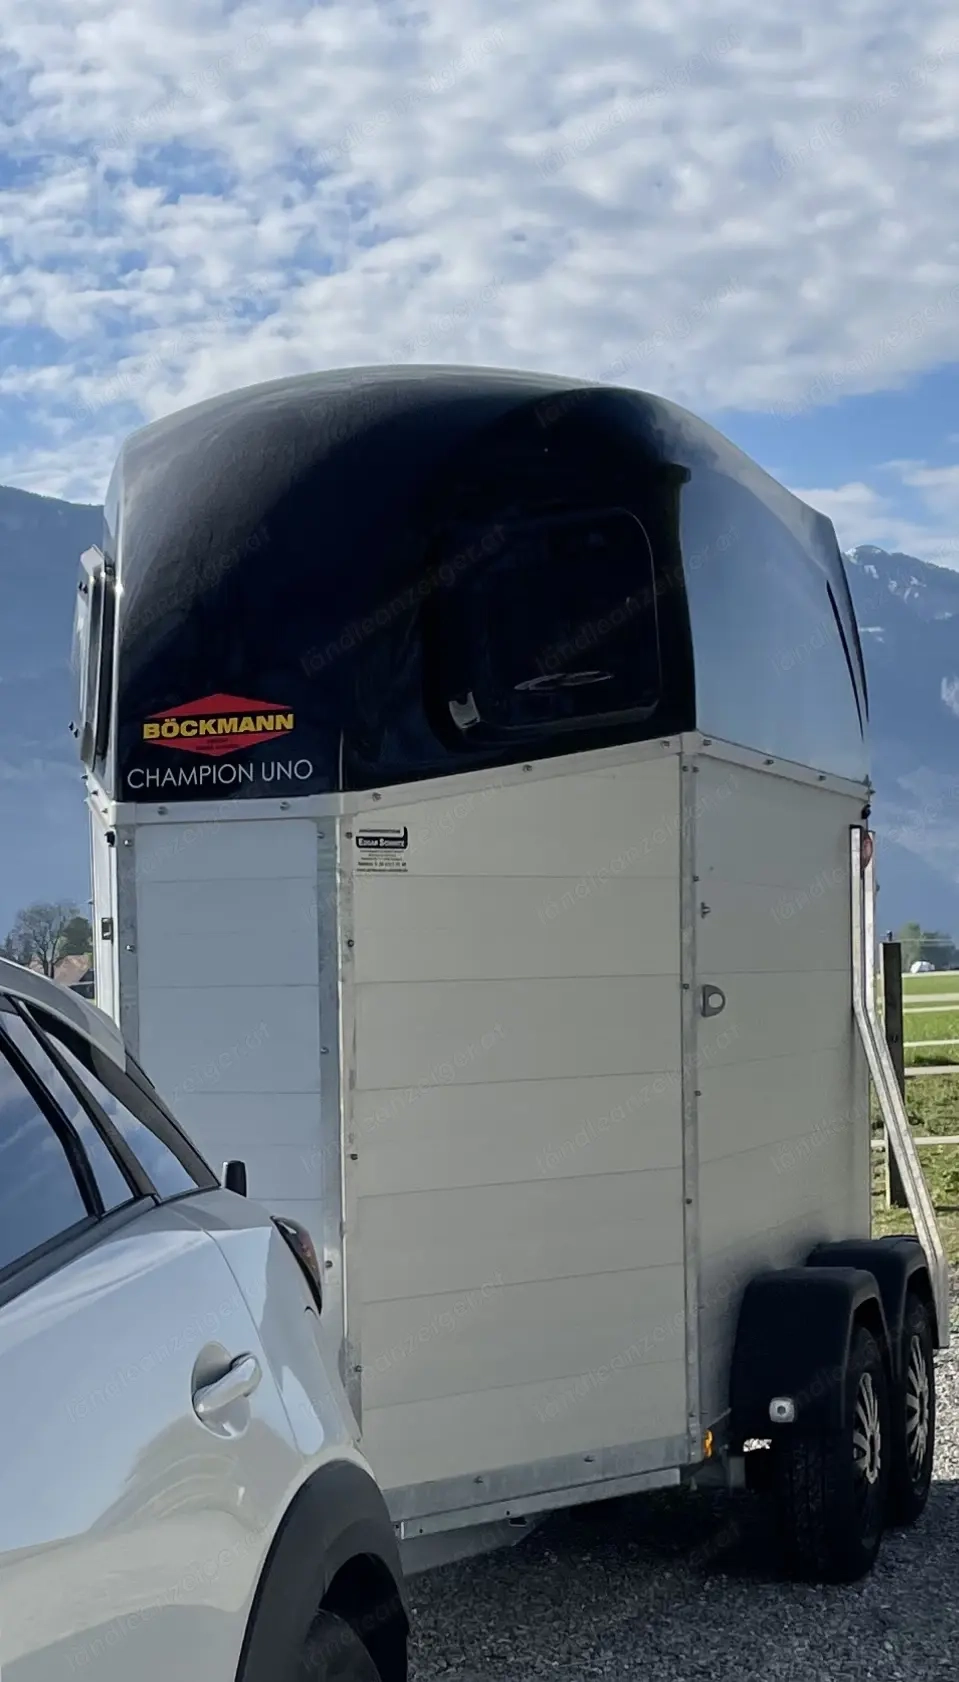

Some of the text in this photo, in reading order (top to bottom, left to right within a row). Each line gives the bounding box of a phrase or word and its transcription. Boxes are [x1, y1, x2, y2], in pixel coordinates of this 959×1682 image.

[143, 713, 295, 740] BÖCKMANN
[127, 758, 314, 789] CHAMPION UNO
